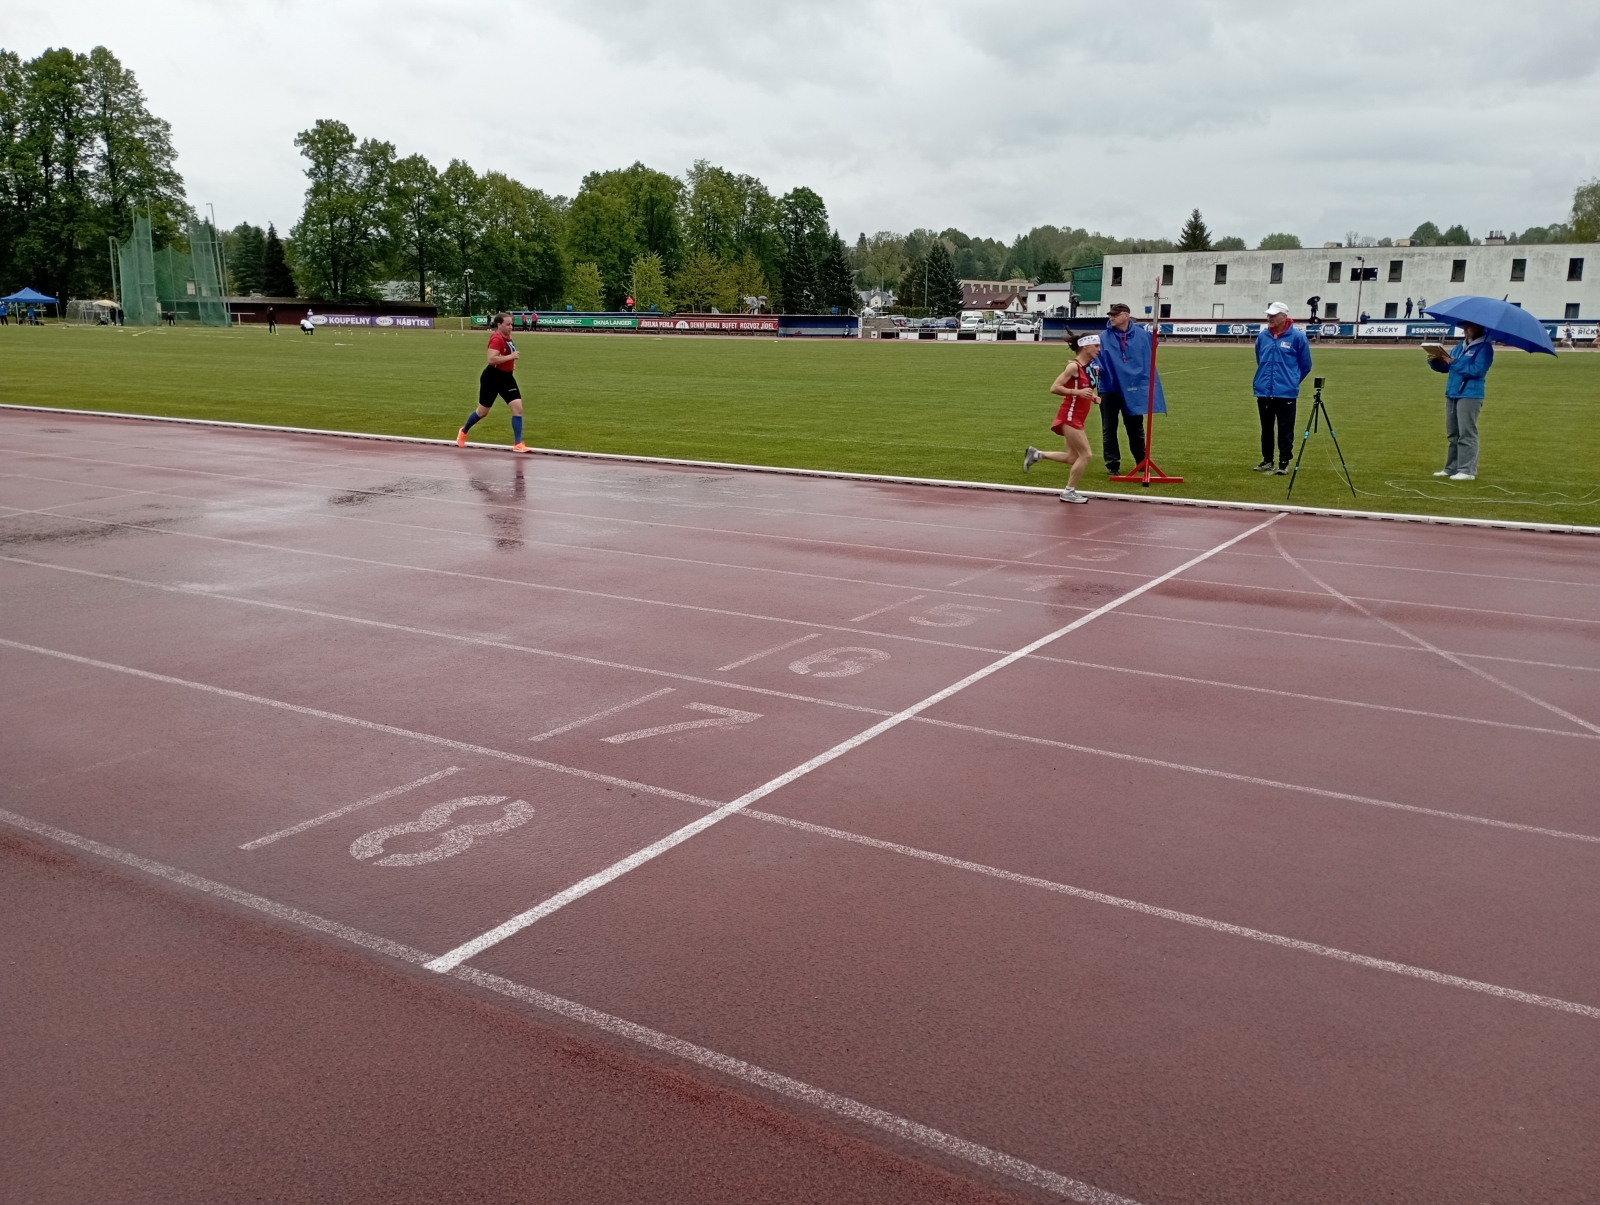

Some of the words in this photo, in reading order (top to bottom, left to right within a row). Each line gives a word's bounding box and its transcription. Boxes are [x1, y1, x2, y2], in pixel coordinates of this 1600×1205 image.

[328, 316, 370, 325] KOUPELNY
[396, 318, 430, 326] NÁBYTEK
[760, 322, 774, 330] JÍDEL
[908, 603, 1002, 628] 5
[788, 646, 891, 678] 6
[600, 701, 764, 745] 7
[349, 795, 535, 867] 8
